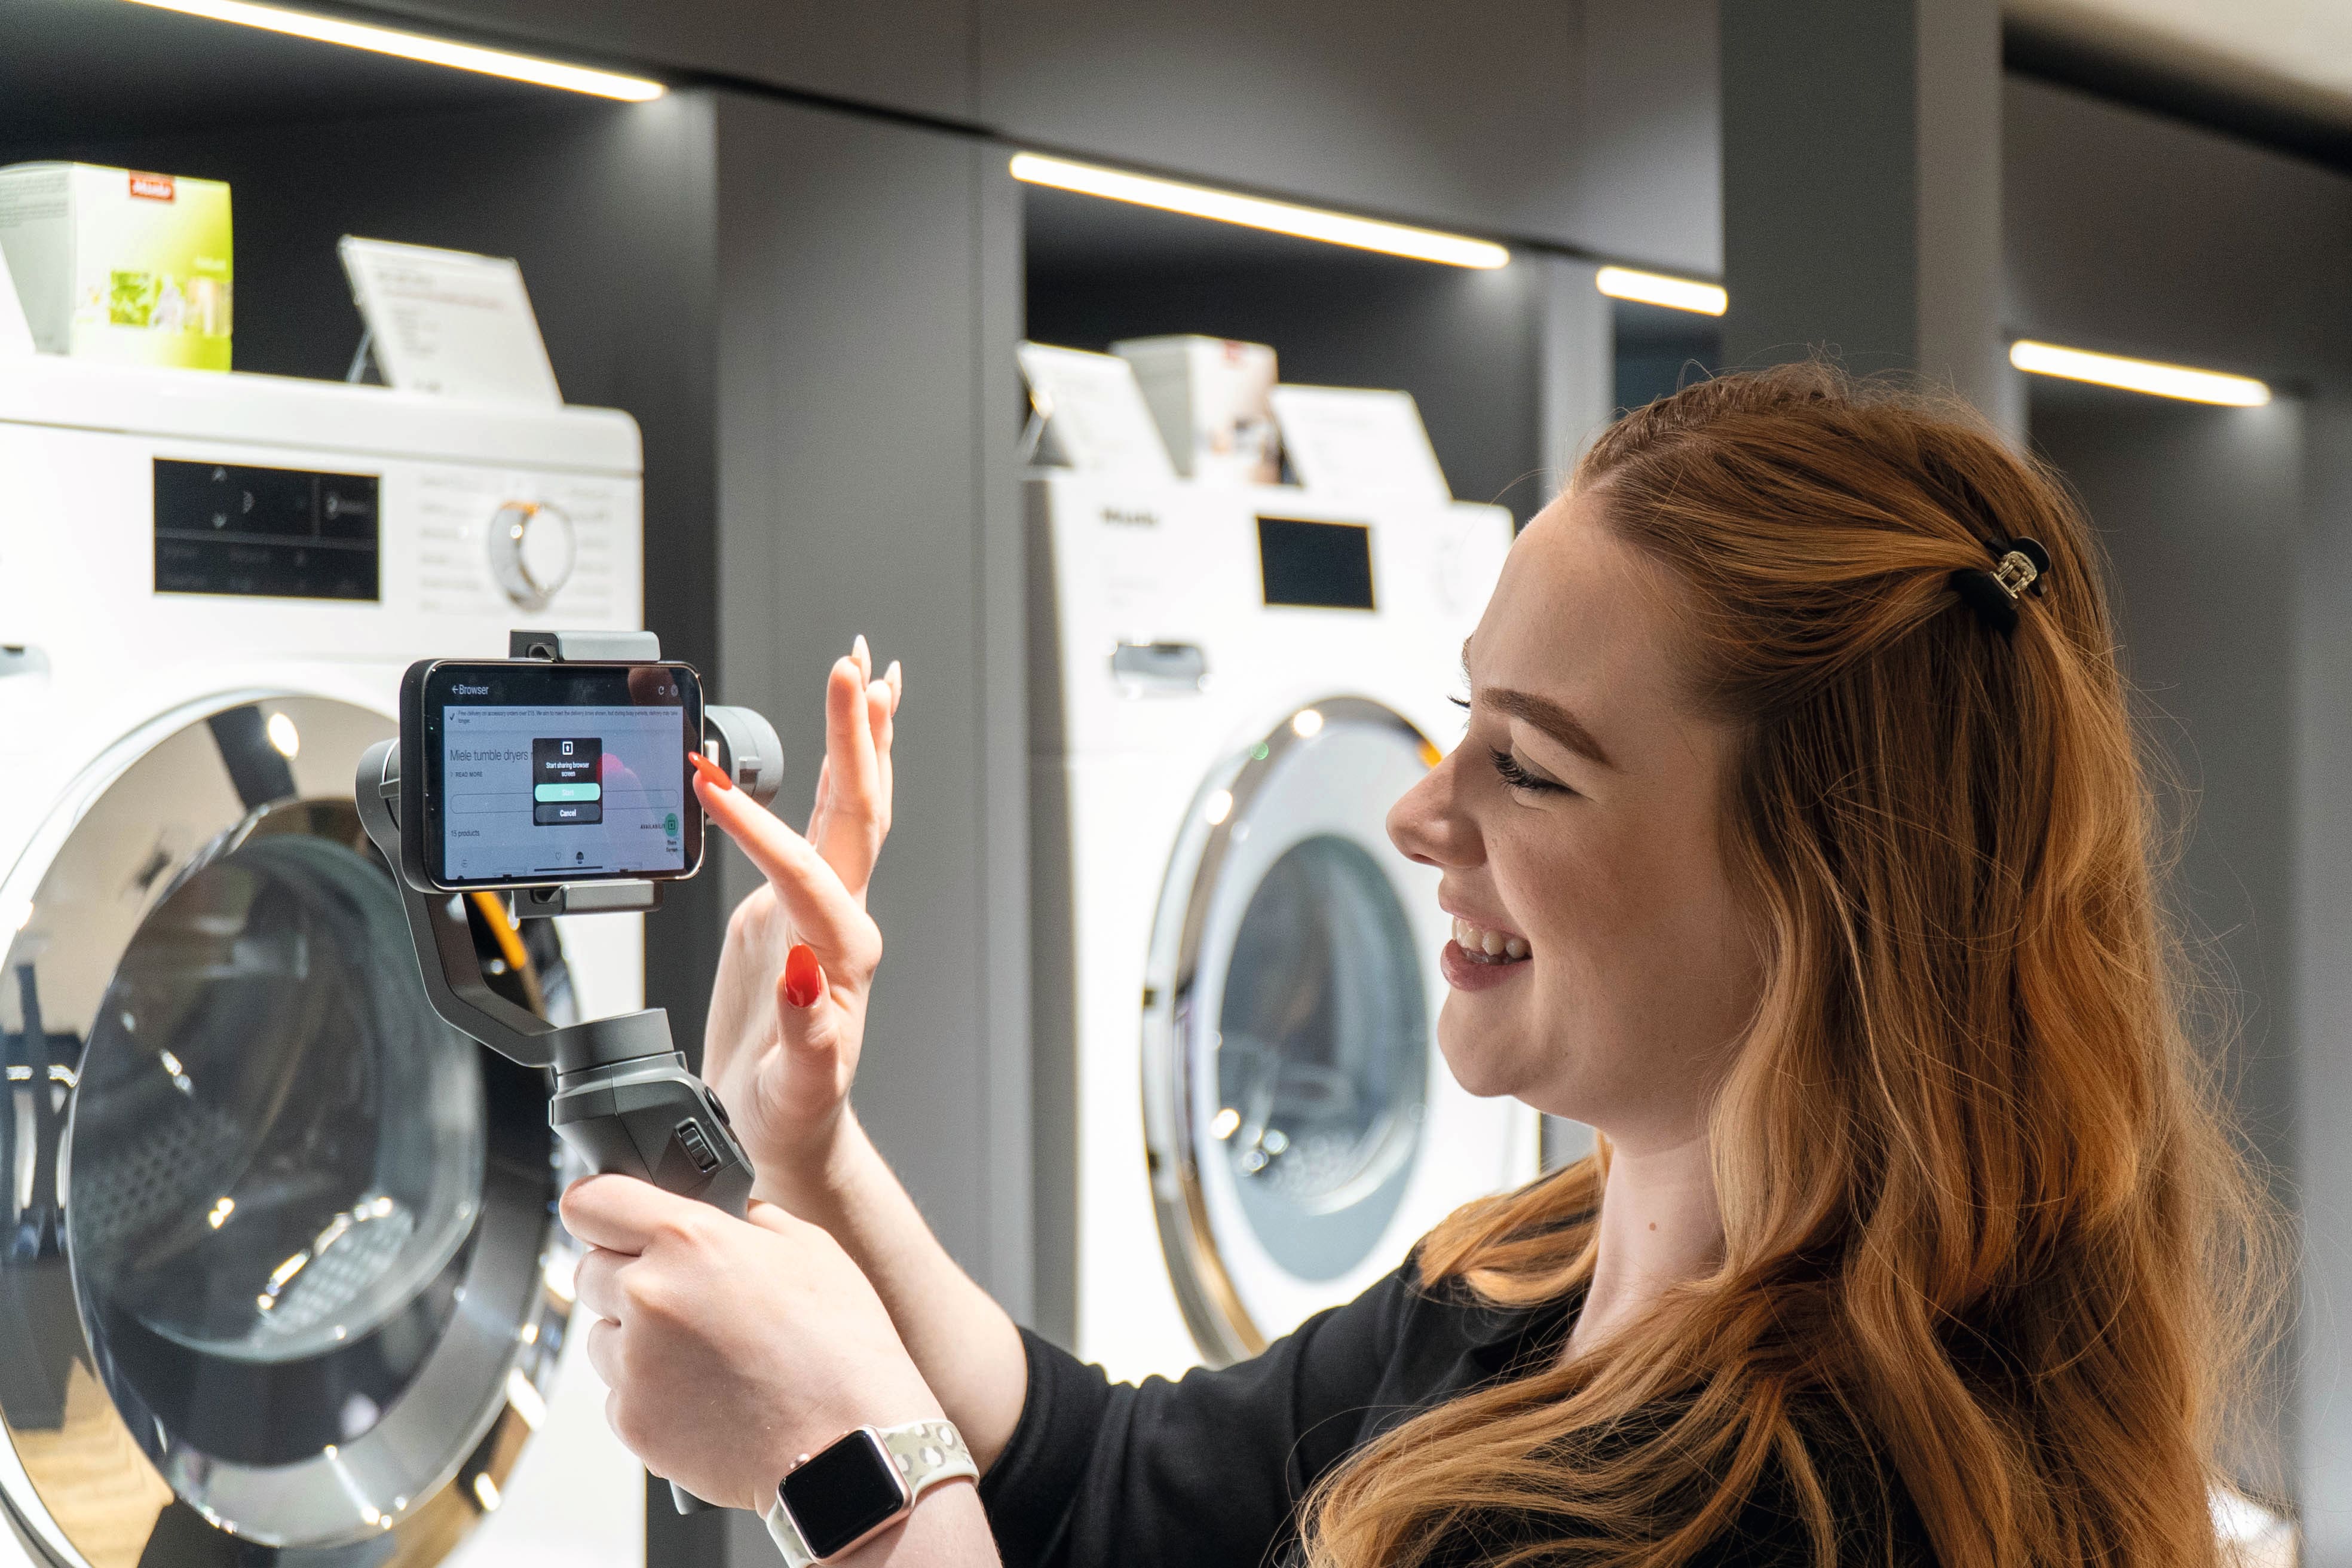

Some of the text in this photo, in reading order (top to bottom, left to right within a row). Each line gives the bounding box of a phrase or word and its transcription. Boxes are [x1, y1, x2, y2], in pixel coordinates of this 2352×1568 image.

[459, 684, 488, 694] Browser
[450, 749, 471, 761] Miele
[474, 749, 502, 761] tumble
[504, 749, 529, 762] dryers
[557, 761, 572, 770] sharing
[458, 829, 480, 838] products
